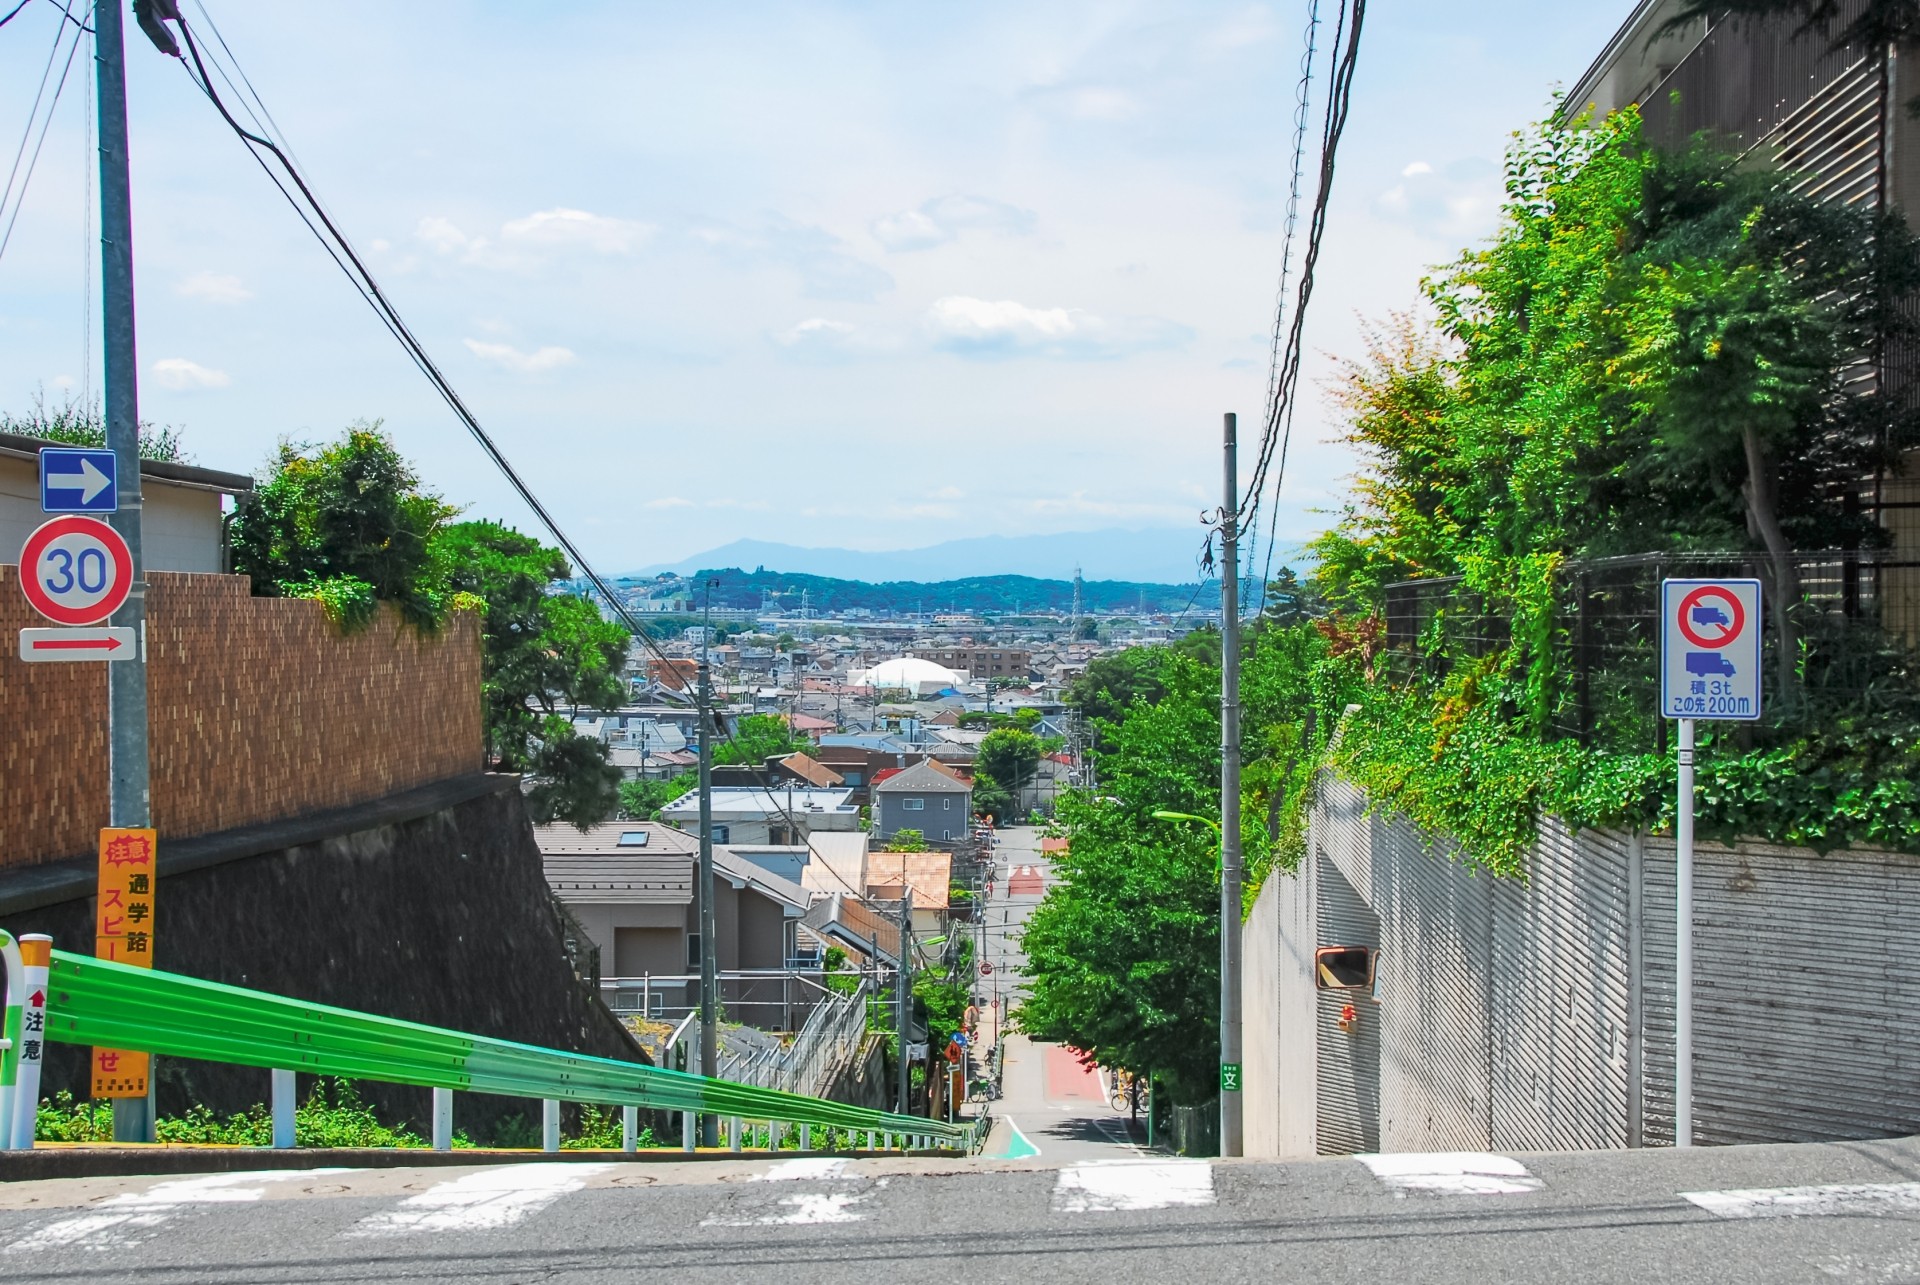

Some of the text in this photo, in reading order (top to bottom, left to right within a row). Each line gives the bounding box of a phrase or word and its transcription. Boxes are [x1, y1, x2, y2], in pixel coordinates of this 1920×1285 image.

[46, 548, 107, 594] 30
[1690, 680, 1732, 695] 積3t
[1673, 697, 1750, 713] この先200m
[109, 841, 146, 862] 注意
[127, 873, 149, 953] 通学路
[22, 1011, 43, 1061] 注意
[1223, 1071, 1237, 1086] 文
